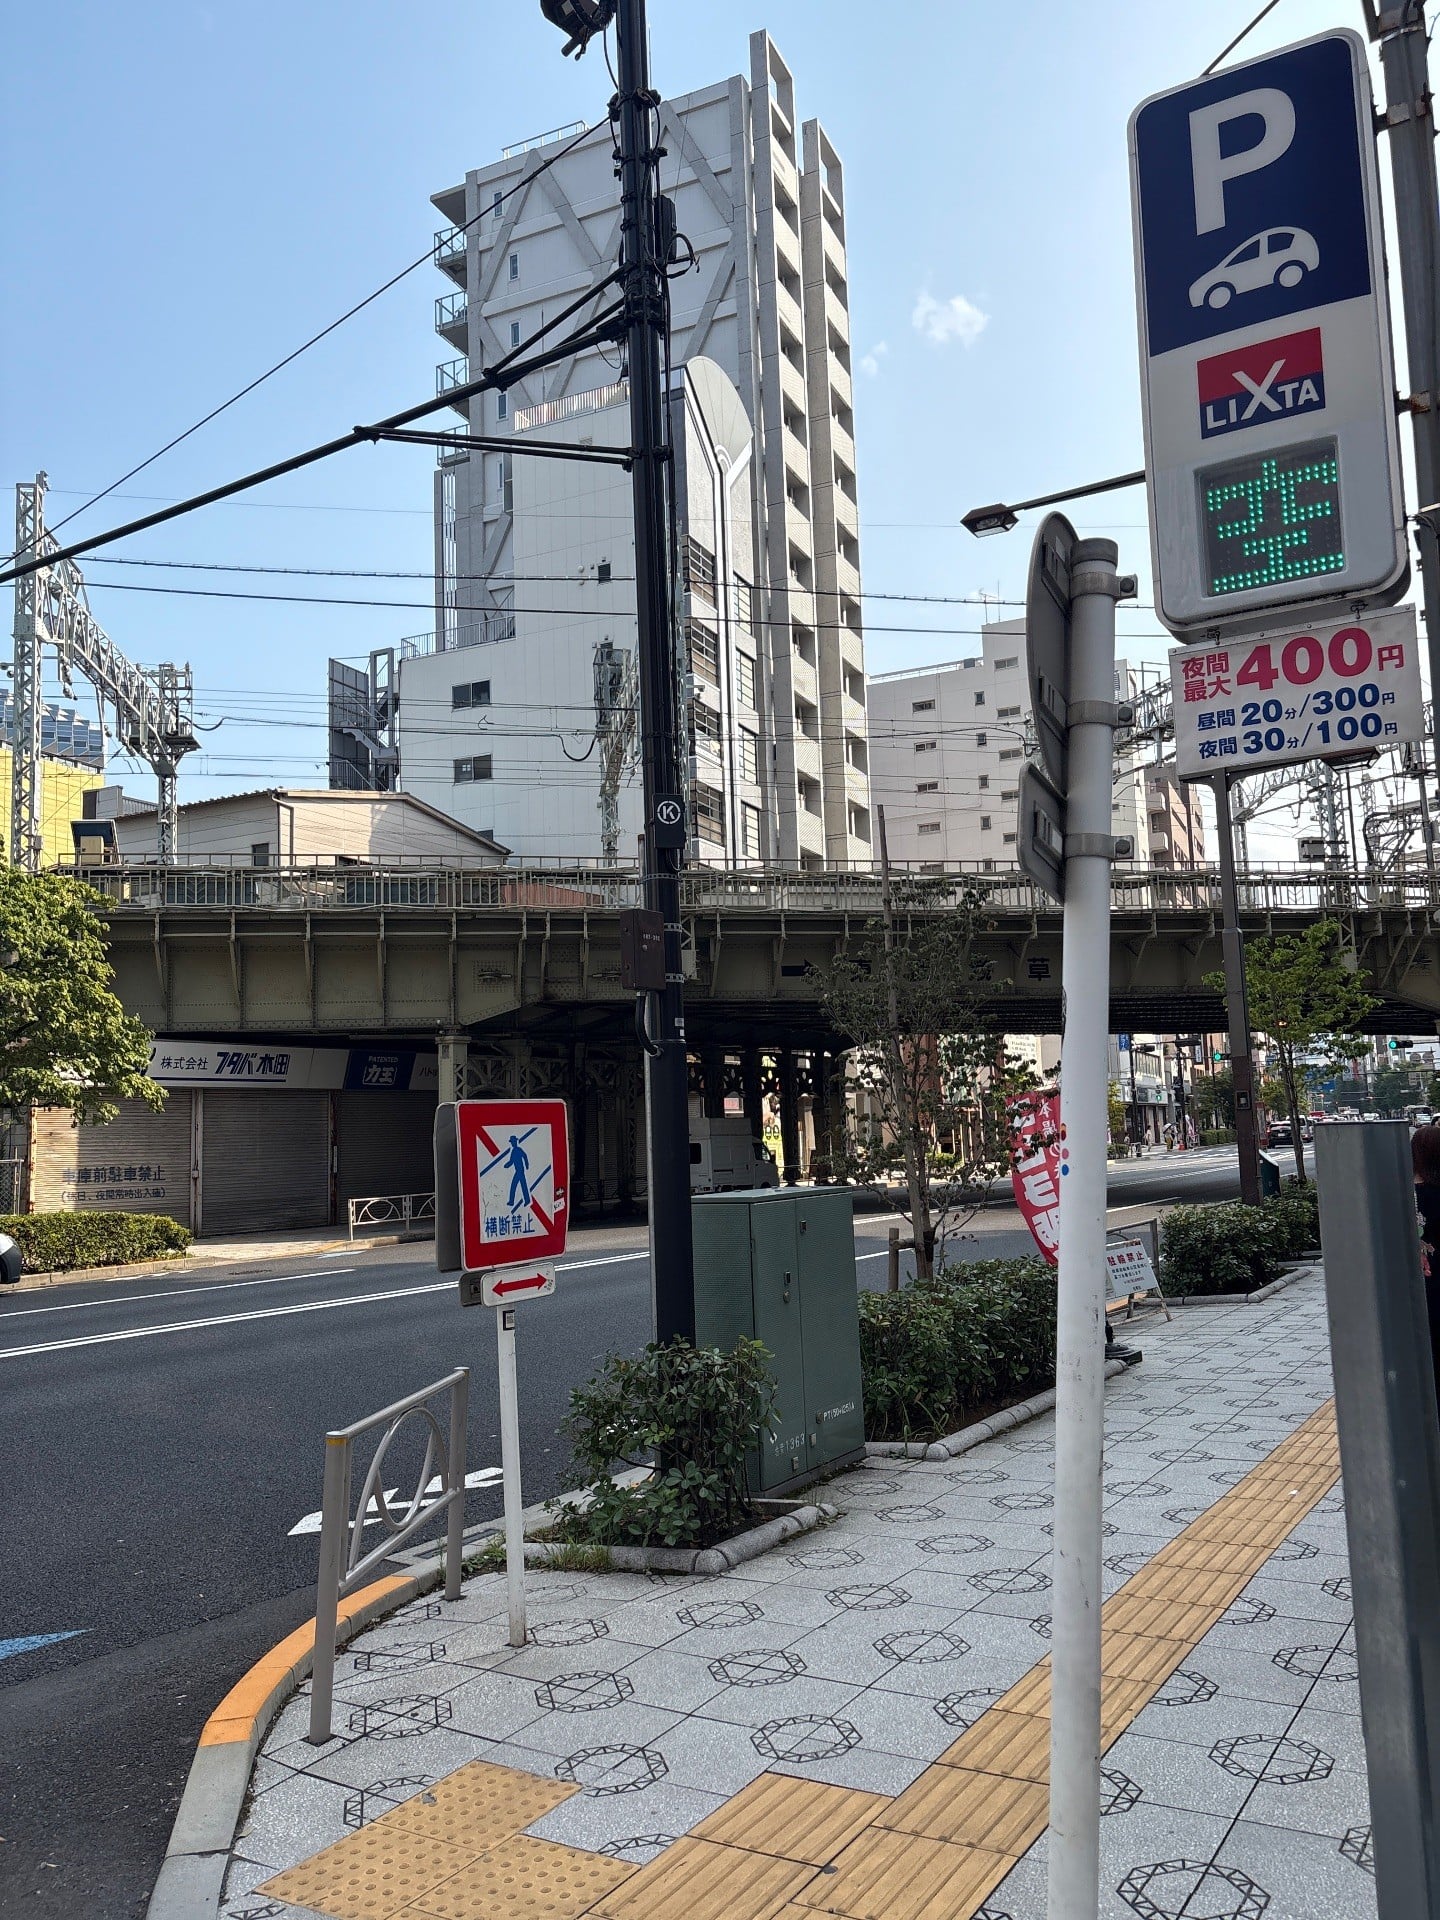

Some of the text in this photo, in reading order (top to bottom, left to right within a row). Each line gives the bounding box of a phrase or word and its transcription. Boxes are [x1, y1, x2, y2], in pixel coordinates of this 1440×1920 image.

[1188, 87, 1296, 236] P
[1205, 358, 1320, 430] LIXTA
[1206, 458, 1345, 594] 空
[1181, 651, 1230, 681] 夜間
[1183, 675, 1232, 704] 最大
[160, 1055, 209, 1071] 株式会社
[484, 1213, 536, 1238] 横断禁止
